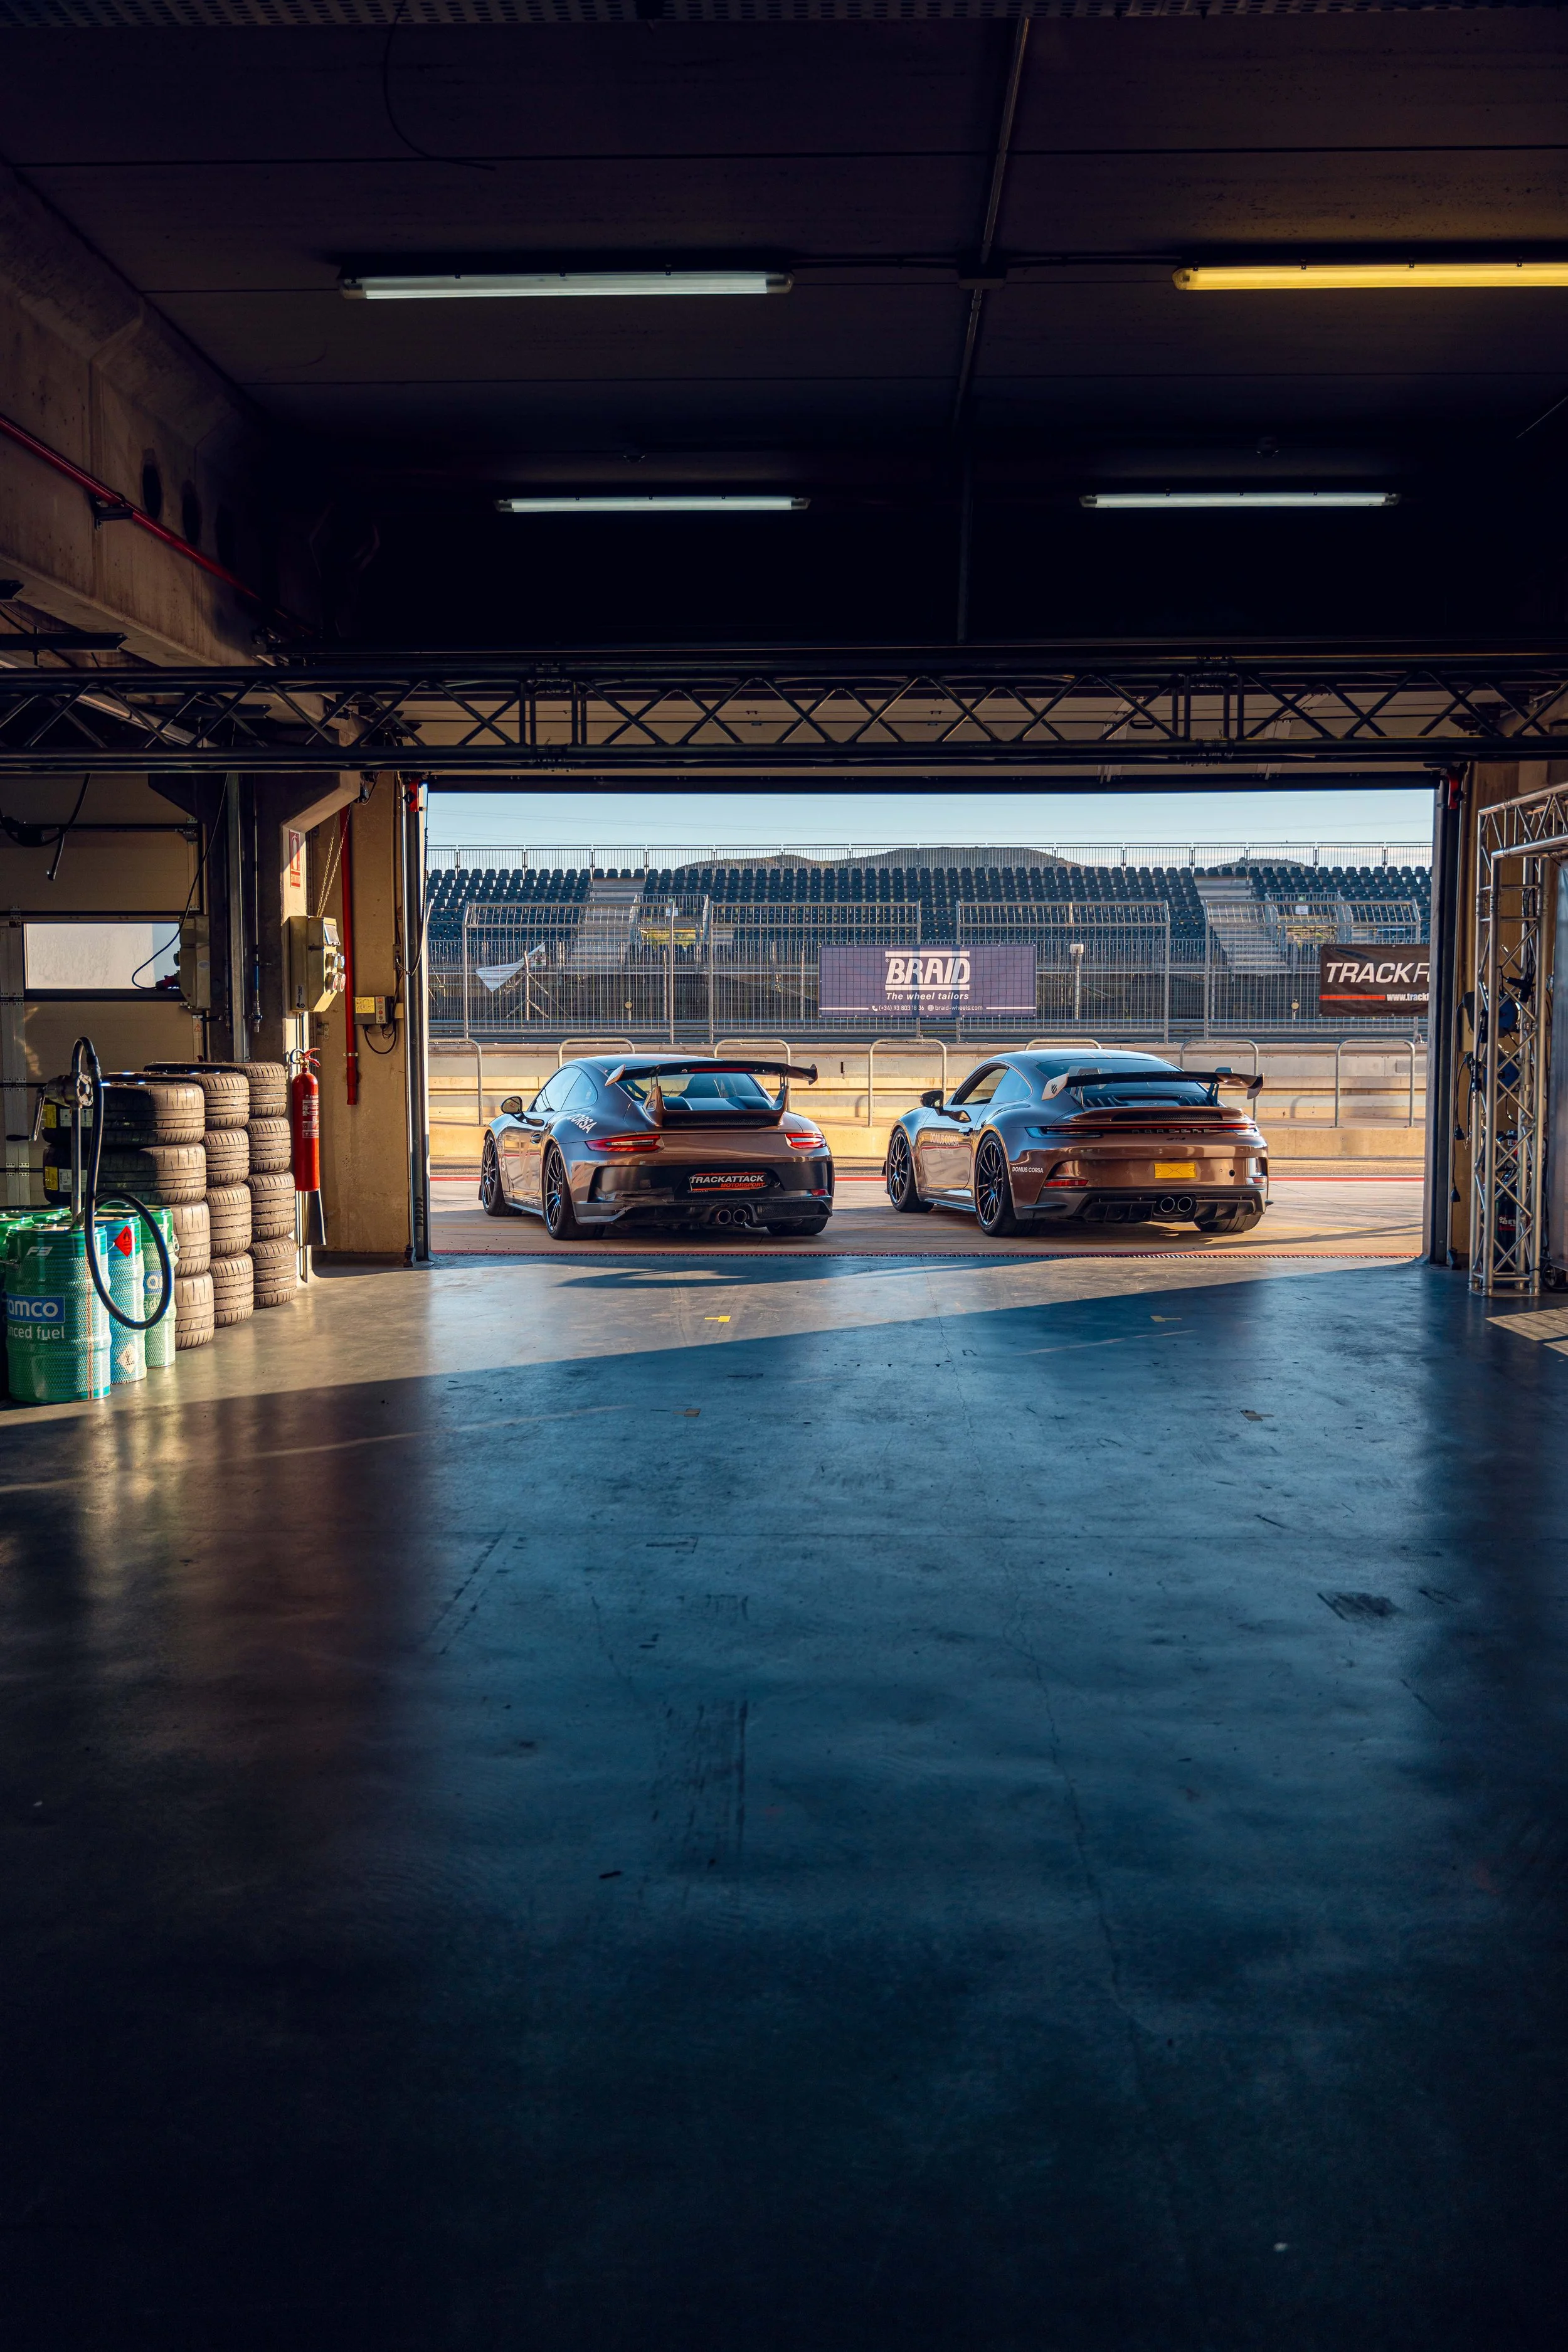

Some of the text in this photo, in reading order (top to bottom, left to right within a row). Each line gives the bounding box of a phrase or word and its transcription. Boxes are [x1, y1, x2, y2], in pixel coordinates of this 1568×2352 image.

[886, 958, 970, 983] BRAID
[690, 1175, 765, 1184] TRACKATTACK
[26, 1246, 53, 1256] F3
[8, 1300, 58, 1317] amco
[37, 1325, 65, 1340] fuel
